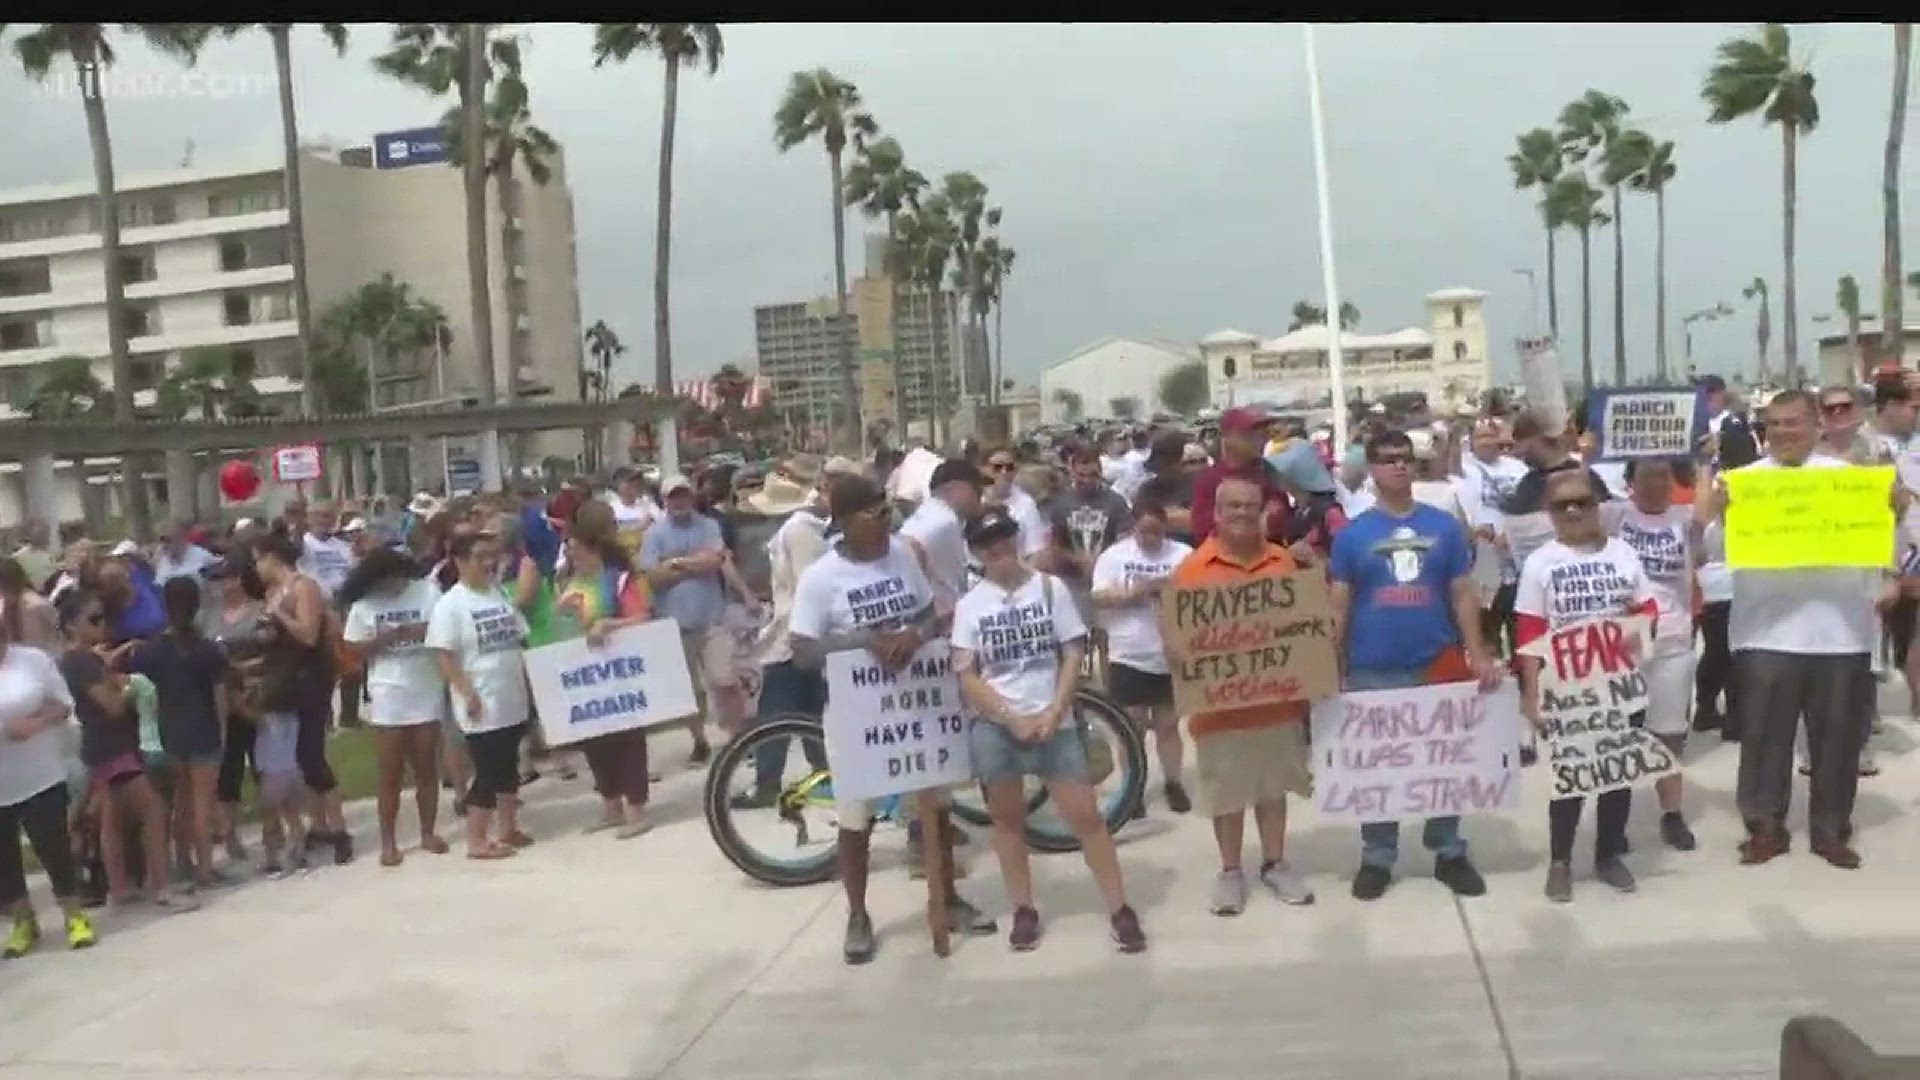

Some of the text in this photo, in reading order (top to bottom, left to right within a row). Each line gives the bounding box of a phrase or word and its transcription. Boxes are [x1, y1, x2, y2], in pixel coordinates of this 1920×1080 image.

[1611, 401, 1676, 416] MARCH
[1611, 418, 1685, 432] FOR OUR
[1550, 562, 1617, 581] MARCH
[1176, 577, 1296, 629] PRAYERS
[1248, 645, 1293, 675] TRY
[1552, 620, 1635, 681] FEAR
[561, 657, 646, 690] NEVER
[911, 657, 952, 679] MAN
[880, 687, 942, 712] MORE
[1608, 672, 1648, 707] NO
[569, 691, 648, 724] AGAIN
[1339, 698, 1487, 739] PARKLAND
[865, 715, 962, 746] HAVE TO
[888, 752, 926, 777] DIE
[1342, 735, 1479, 769] WAS THE
[1554, 742, 1673, 795] SCHOOLS
[1321, 773, 1511, 815] LAST STRAW
